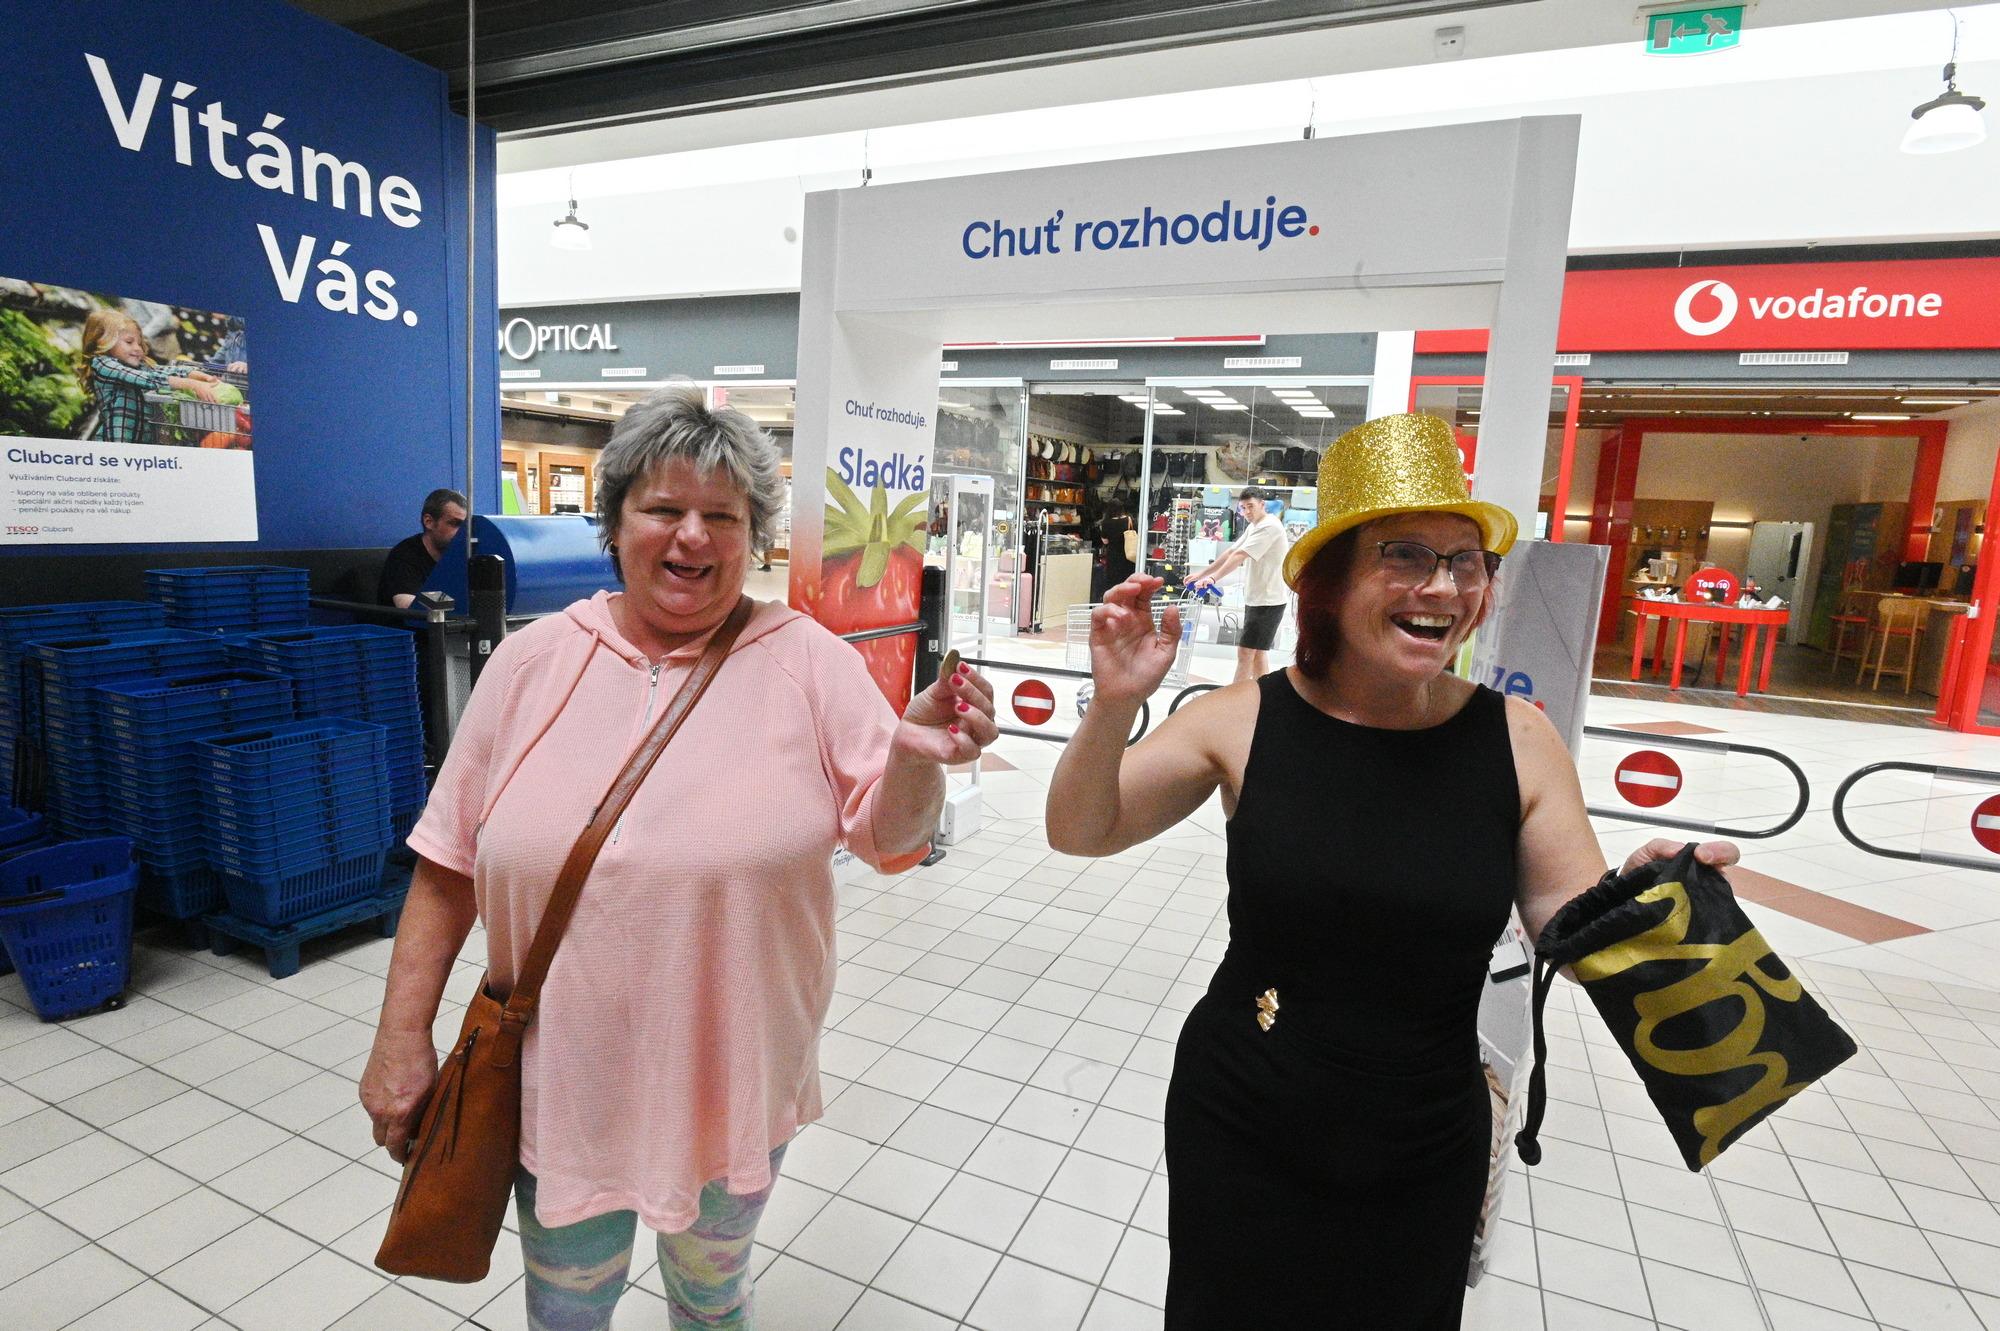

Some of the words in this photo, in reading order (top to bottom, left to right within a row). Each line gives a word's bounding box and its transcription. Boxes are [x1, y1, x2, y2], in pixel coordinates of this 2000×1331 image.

[84, 52, 423, 229] Vítáme
[961, 208, 1065, 260] Chuť
[1073, 195, 1321, 253] rozhoduje.
[256, 222, 419, 328] Vás.
[1747, 286, 1943, 321] vodafone
[845, 399, 875, 419] Chuť
[875, 407, 928, 430] rozhoduje.
[7, 448, 95, 467] Clubcard
[99, 455, 119, 468] se
[123, 455, 184, 472] vyplatí.
[838, 446, 925, 492] Sladká
[56, 474, 92, 483] Clubcard
[5, 525, 40, 535] TESCO
